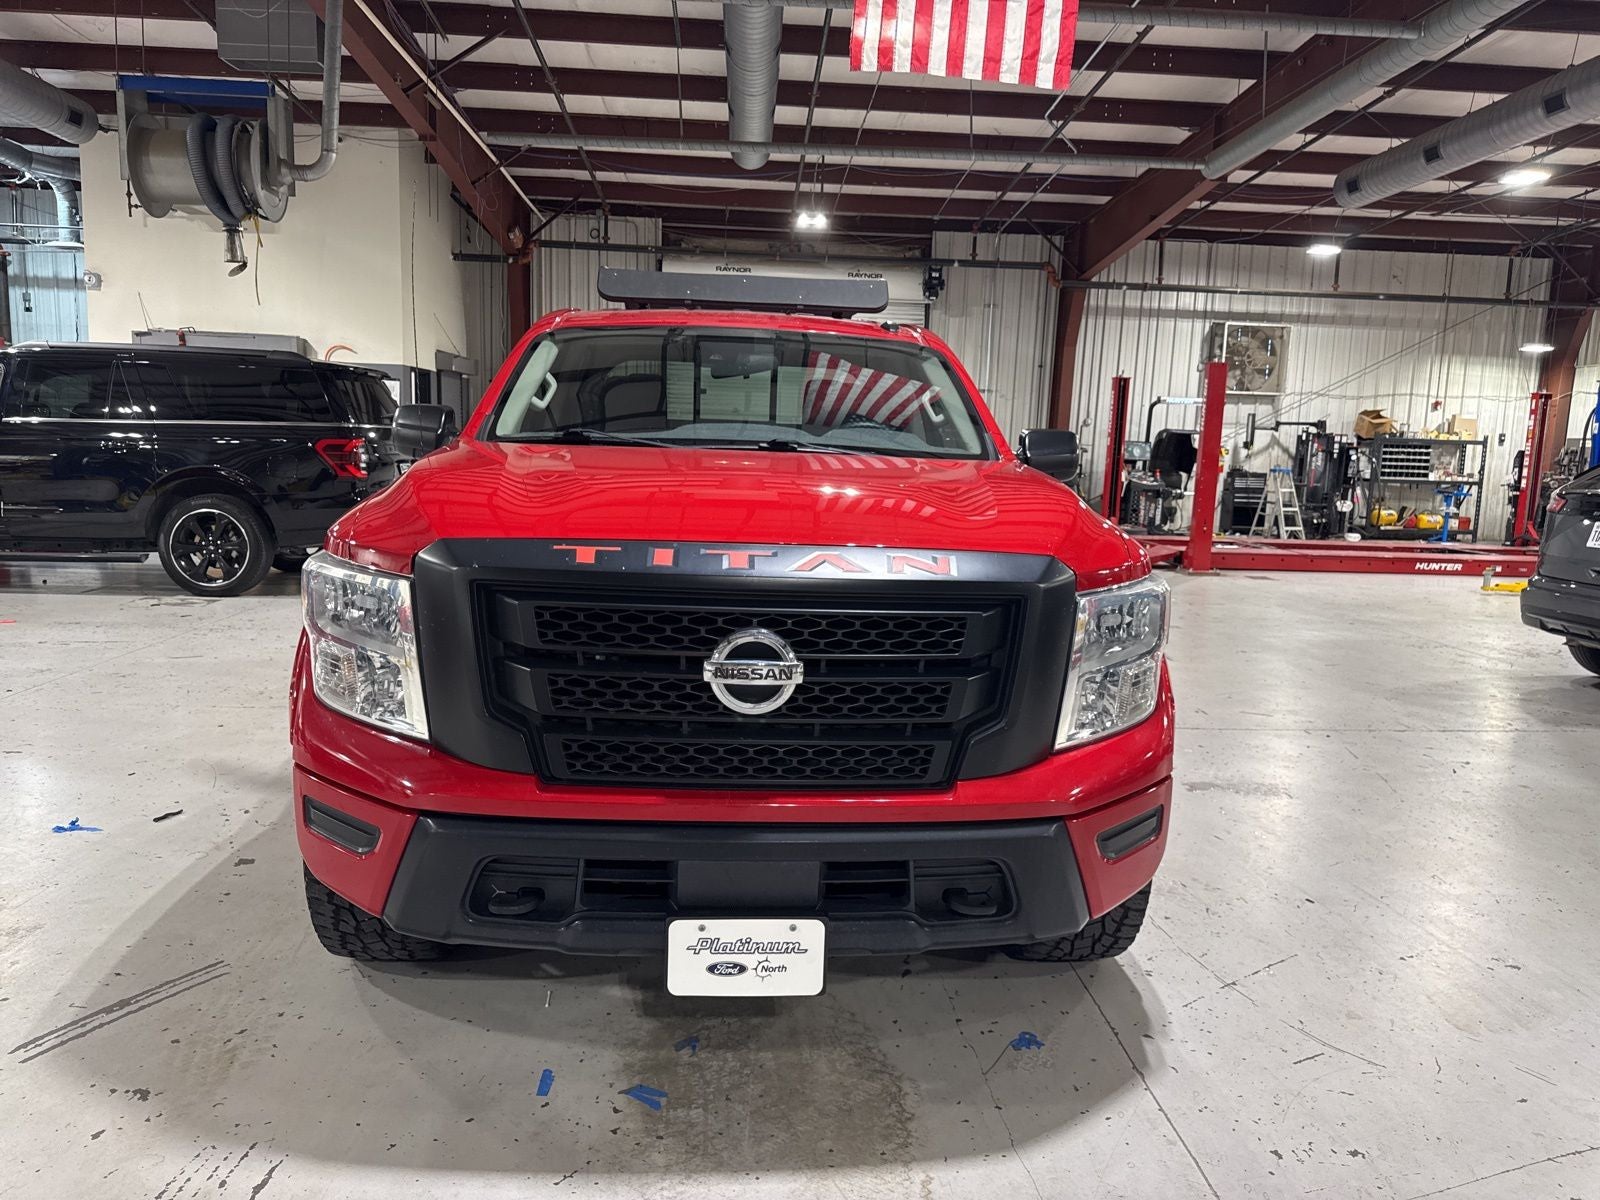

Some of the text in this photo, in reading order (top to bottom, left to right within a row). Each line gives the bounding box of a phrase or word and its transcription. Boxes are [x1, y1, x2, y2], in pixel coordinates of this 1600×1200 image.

[715, 265, 752, 273] RAYNOR
[847, 271, 883, 279] RAYNOR
[553, 544, 959, 576] TITAN
[1415, 562, 1463, 571] HUNTER
[713, 667, 793, 681] NISSAN
[686, 937, 808, 955] Platinum
[713, 962, 787, 975] Ford North
